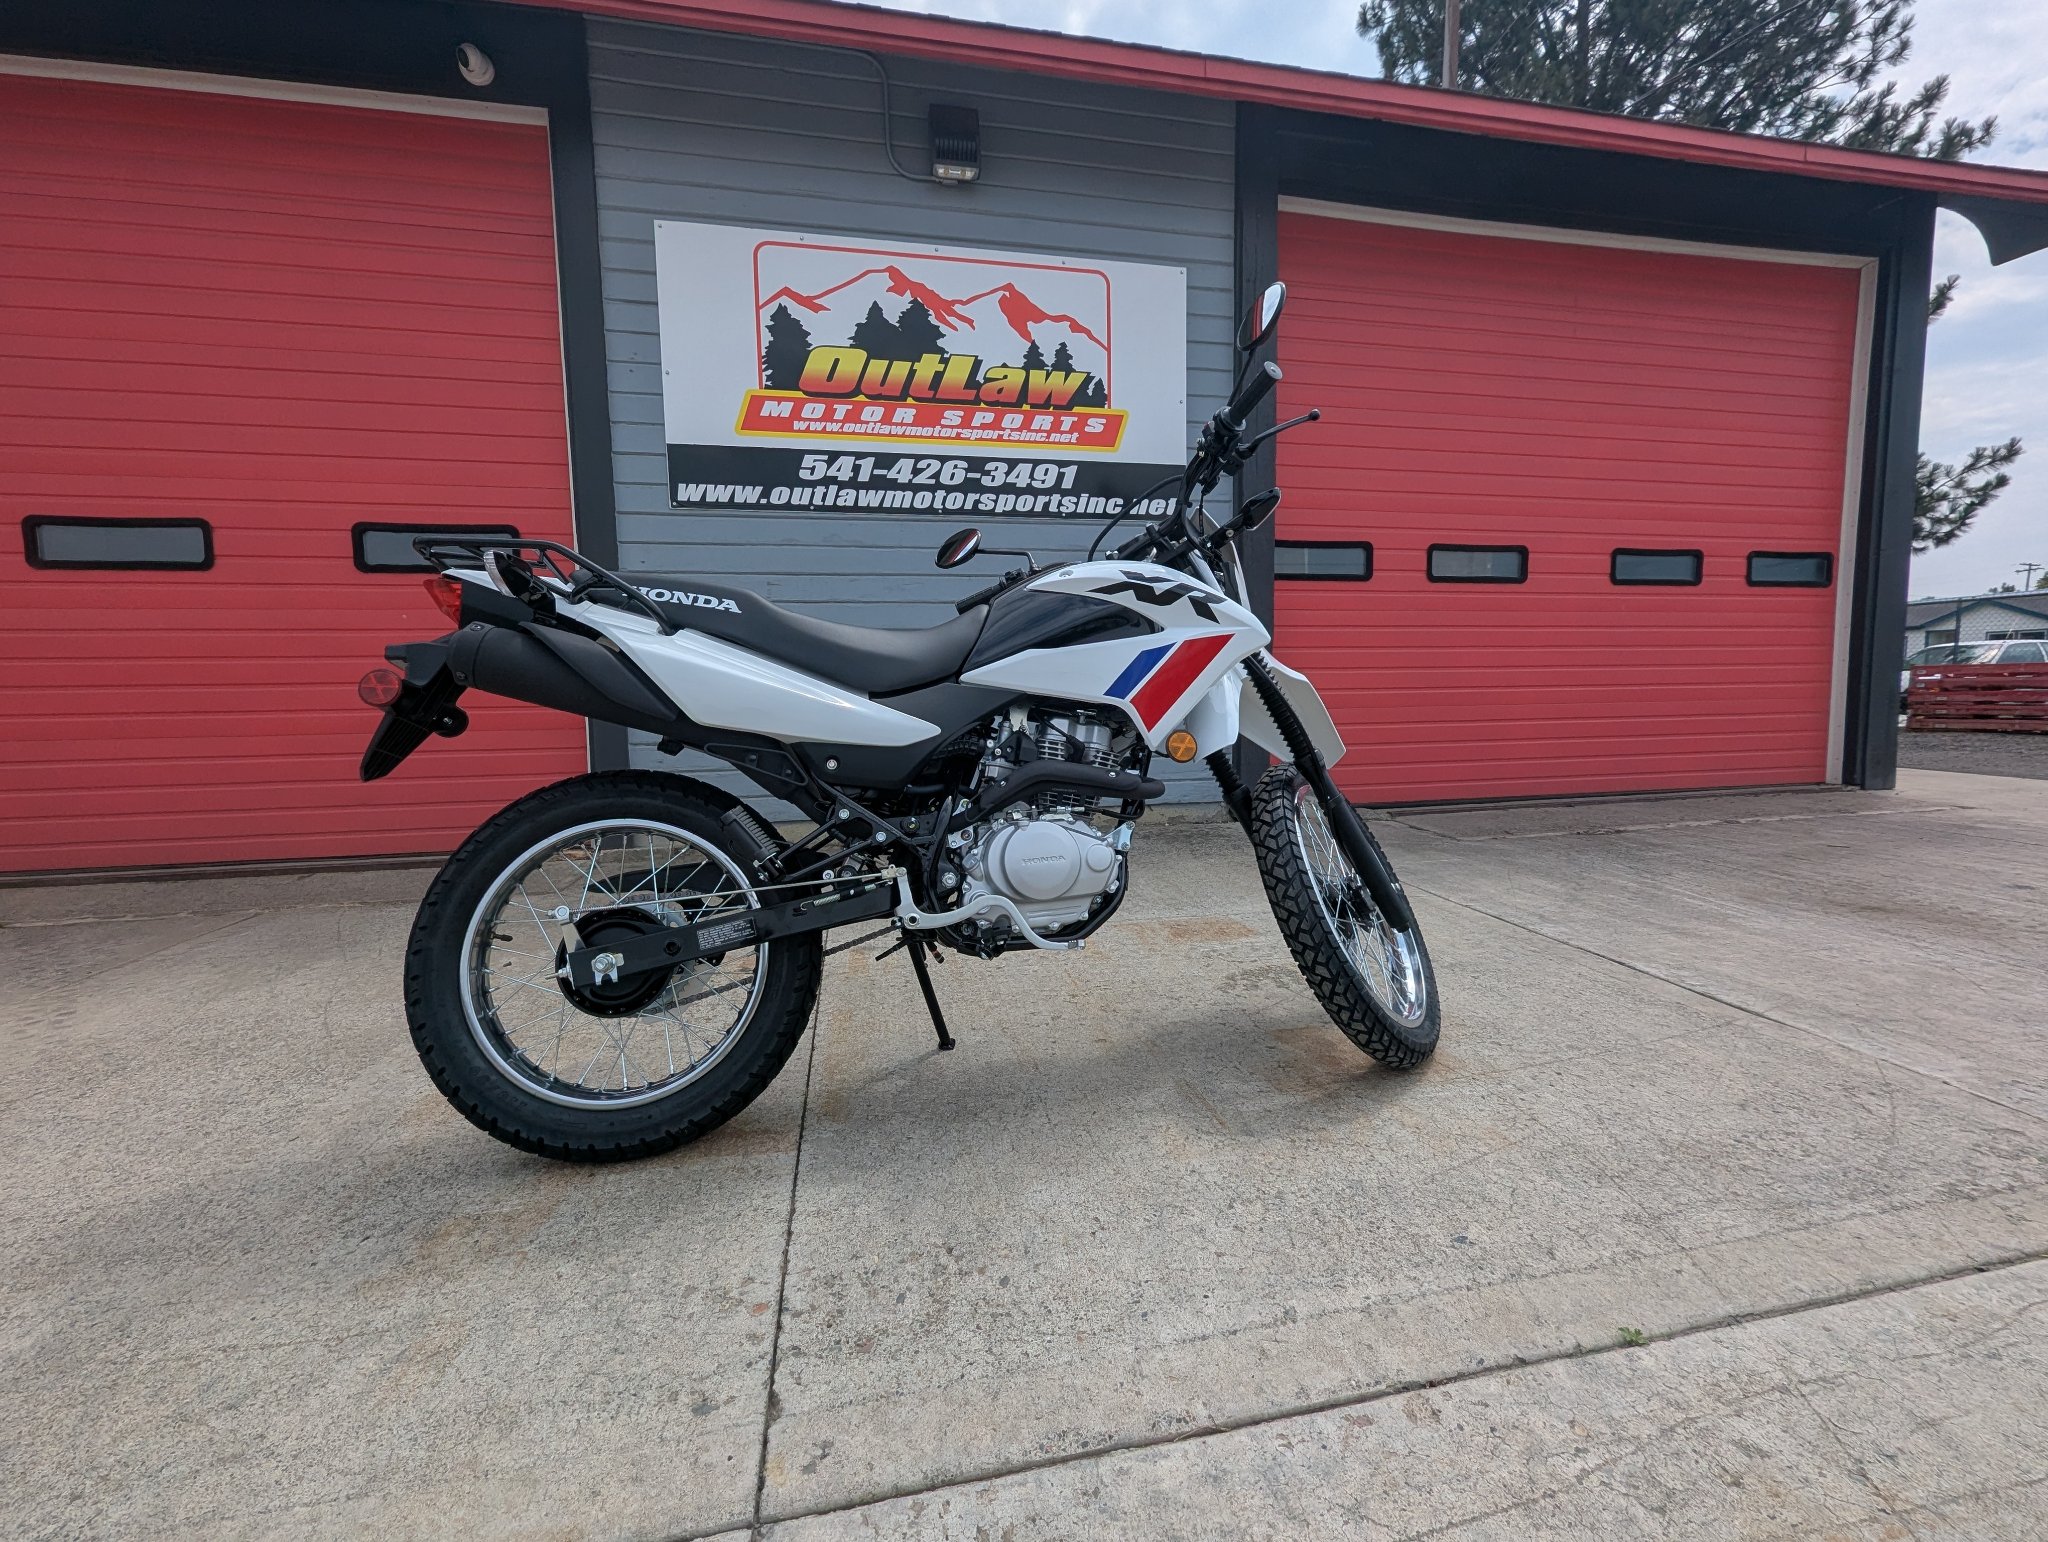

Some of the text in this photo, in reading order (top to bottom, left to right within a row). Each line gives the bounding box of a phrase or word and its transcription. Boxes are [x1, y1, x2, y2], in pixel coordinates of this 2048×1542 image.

[799, 346, 1090, 406] OutLaw
[759, 400, 1107, 433] MOTOR SPORTS
[793, 420, 1079, 443] www.outlawmotorsportsinc.net
[798, 454, 1079, 489] 541-426-3491
[677, 482, 1178, 516] www.outlawmotorsportsincnet
[1021, 854, 1067, 866] HONDA
